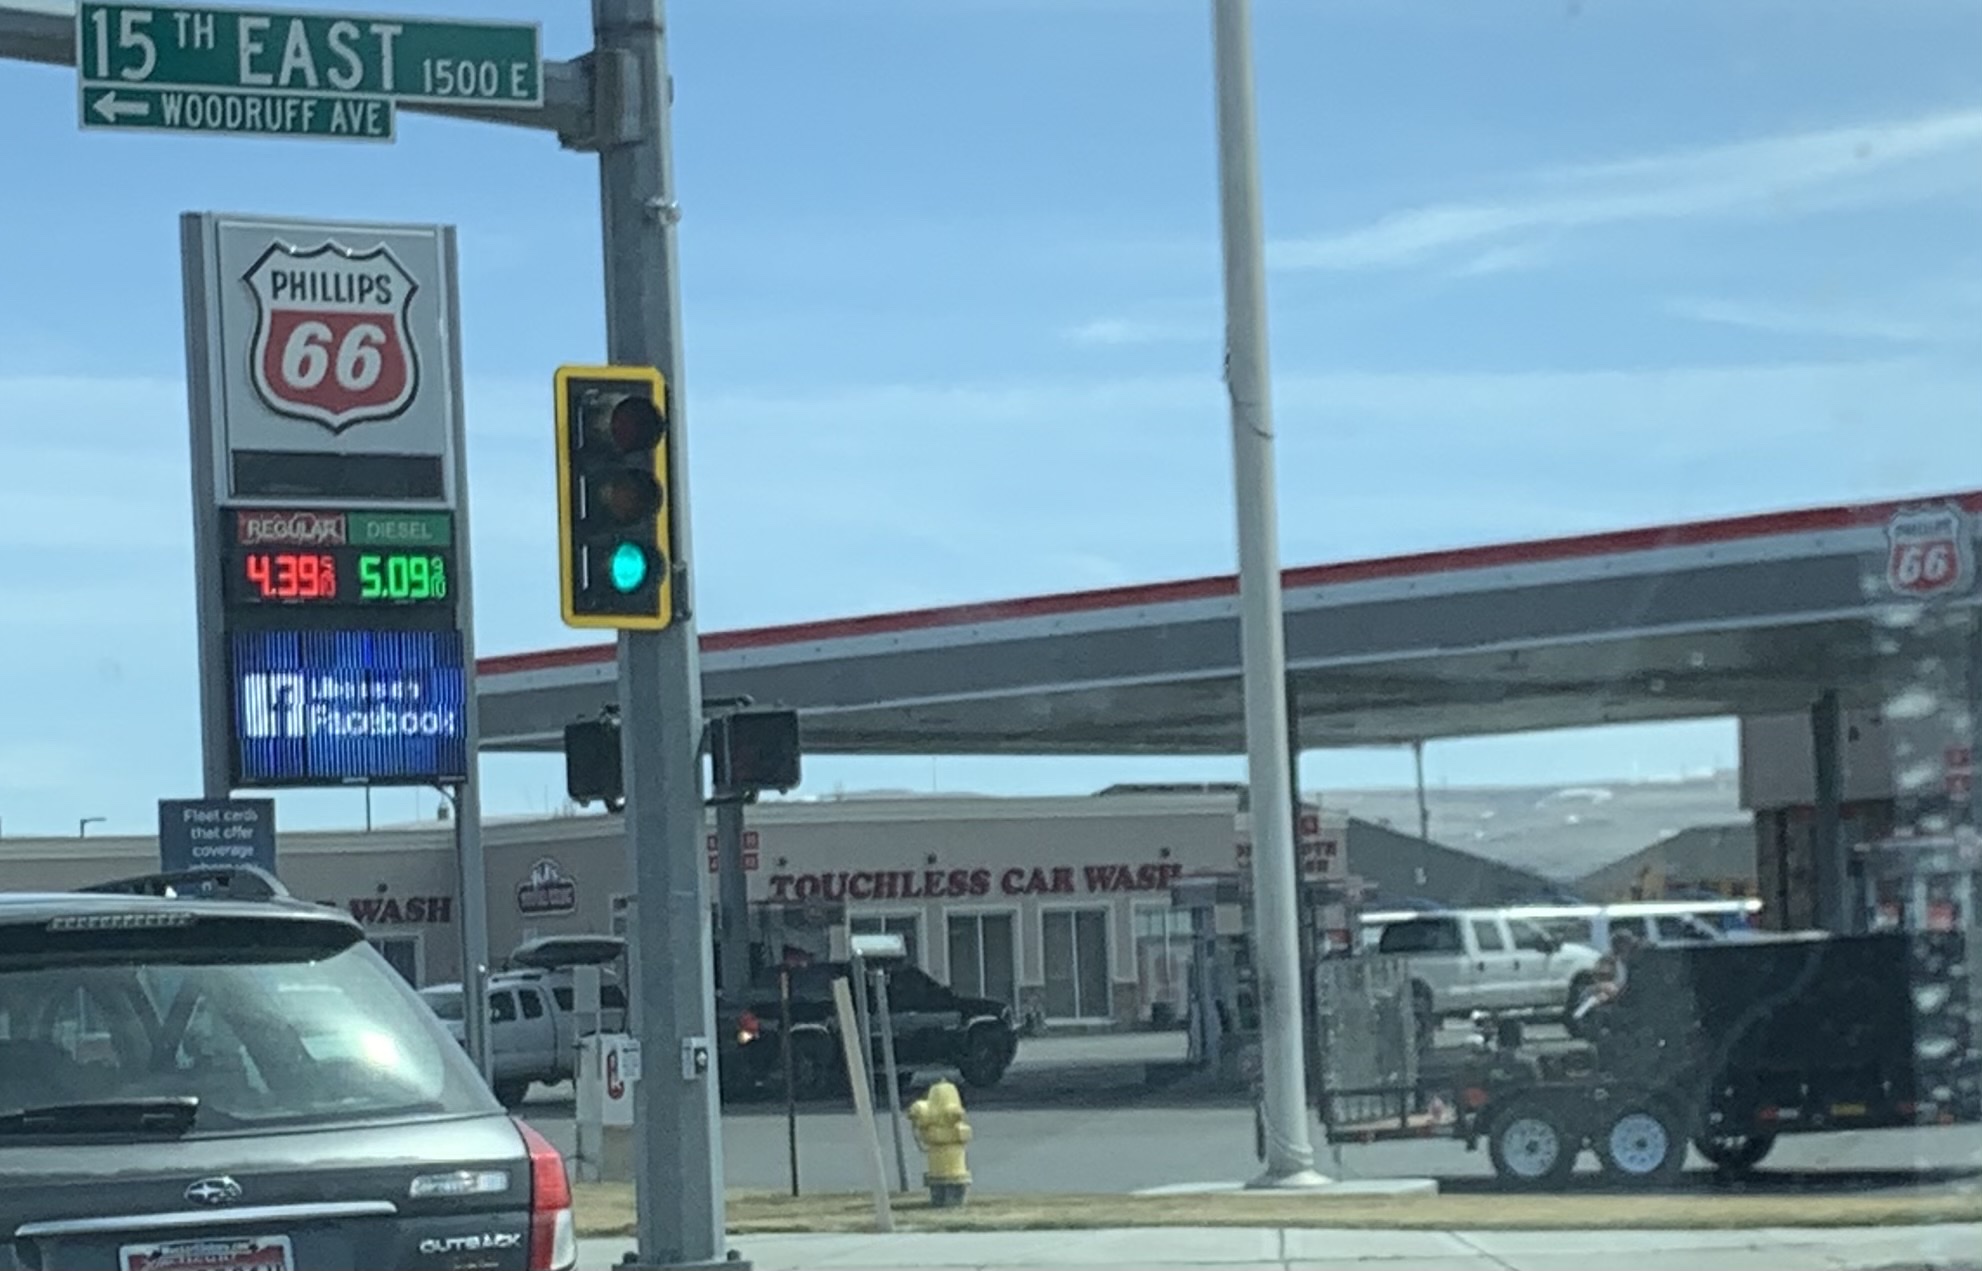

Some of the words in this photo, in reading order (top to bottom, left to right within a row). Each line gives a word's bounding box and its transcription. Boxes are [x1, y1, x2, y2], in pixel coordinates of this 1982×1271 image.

[92, 9, 156, 80] 15
[173, 13, 214, 49] TH
[238, 16, 402, 91] EAST
[423, 59, 499, 97] 1500
[511, 62, 529, 97] E
[161, 93, 317, 132] WOODRUFF
[330, 101, 383, 134] AVE
[271, 270, 392, 305] PHILLIPS
[282, 320, 387, 391] 66
[248, 518, 338, 540] REGULAR
[367, 521, 433, 539] DIESEL
[1900, 545, 1948, 584] 66
[191, 826, 220, 840] that
[192, 846, 254, 858] coverage
[770, 867, 992, 901] TOUCHLESS
[1001, 866, 1076, 895] CAR
[1084, 862, 1182, 894] WASH
[349, 896, 450, 923] WASH
[419, 1233, 521, 1254] OUTBACK
